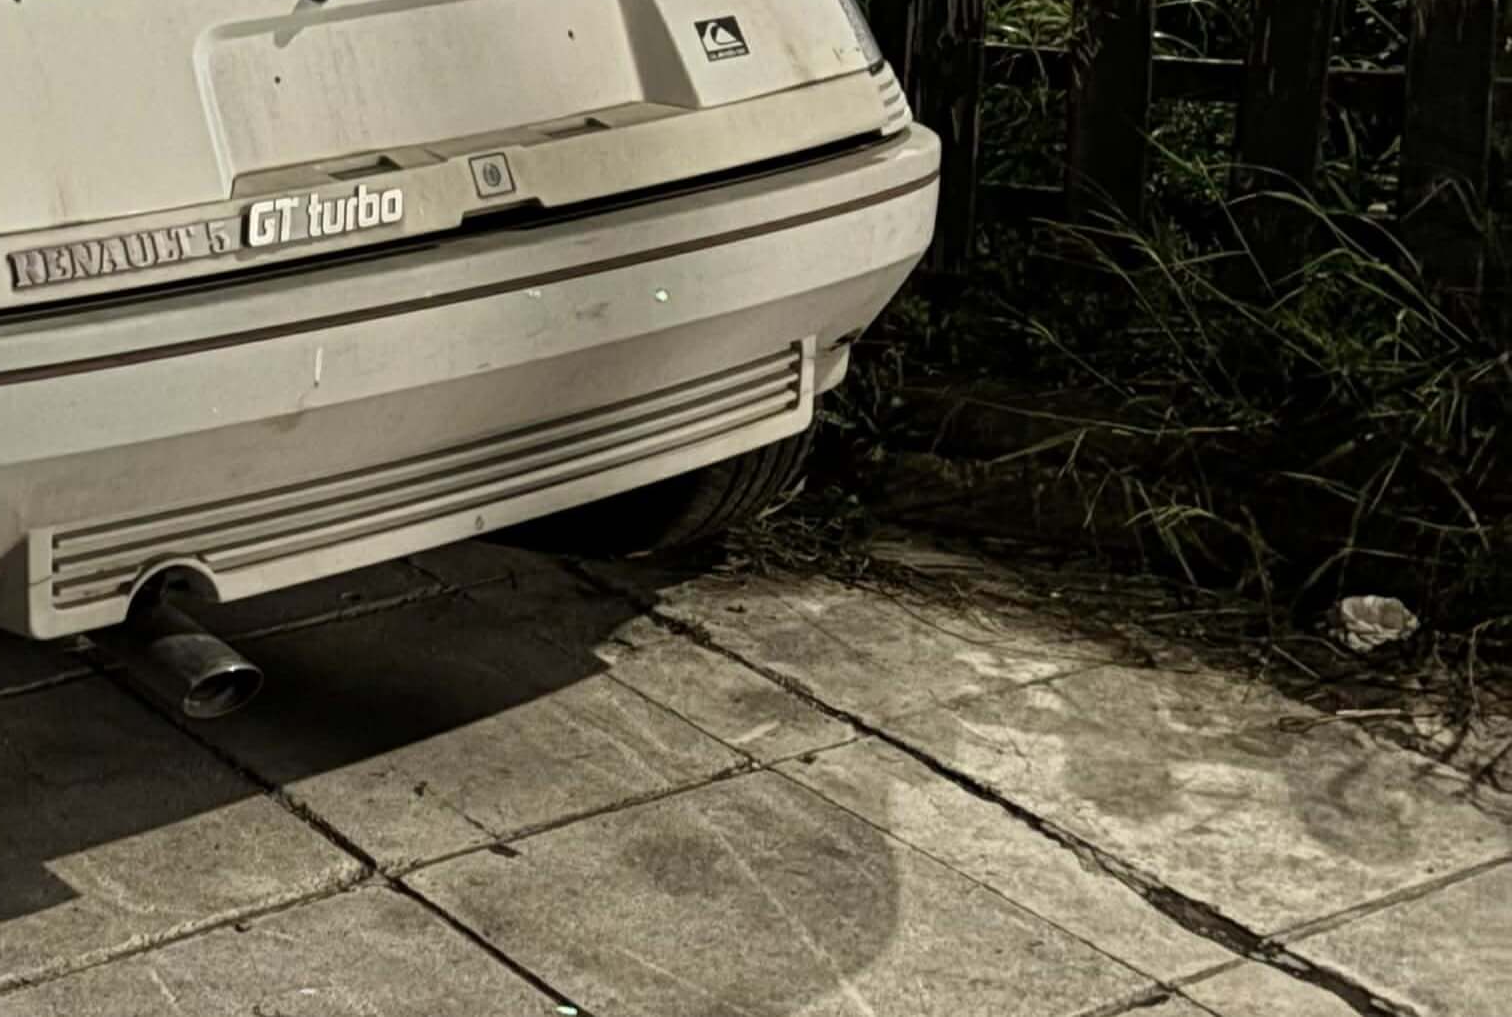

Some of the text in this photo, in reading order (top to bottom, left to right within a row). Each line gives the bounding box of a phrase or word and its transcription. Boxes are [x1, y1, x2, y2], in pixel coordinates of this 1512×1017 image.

[8, 185, 404, 288] RENAULT 5 GT turbo
